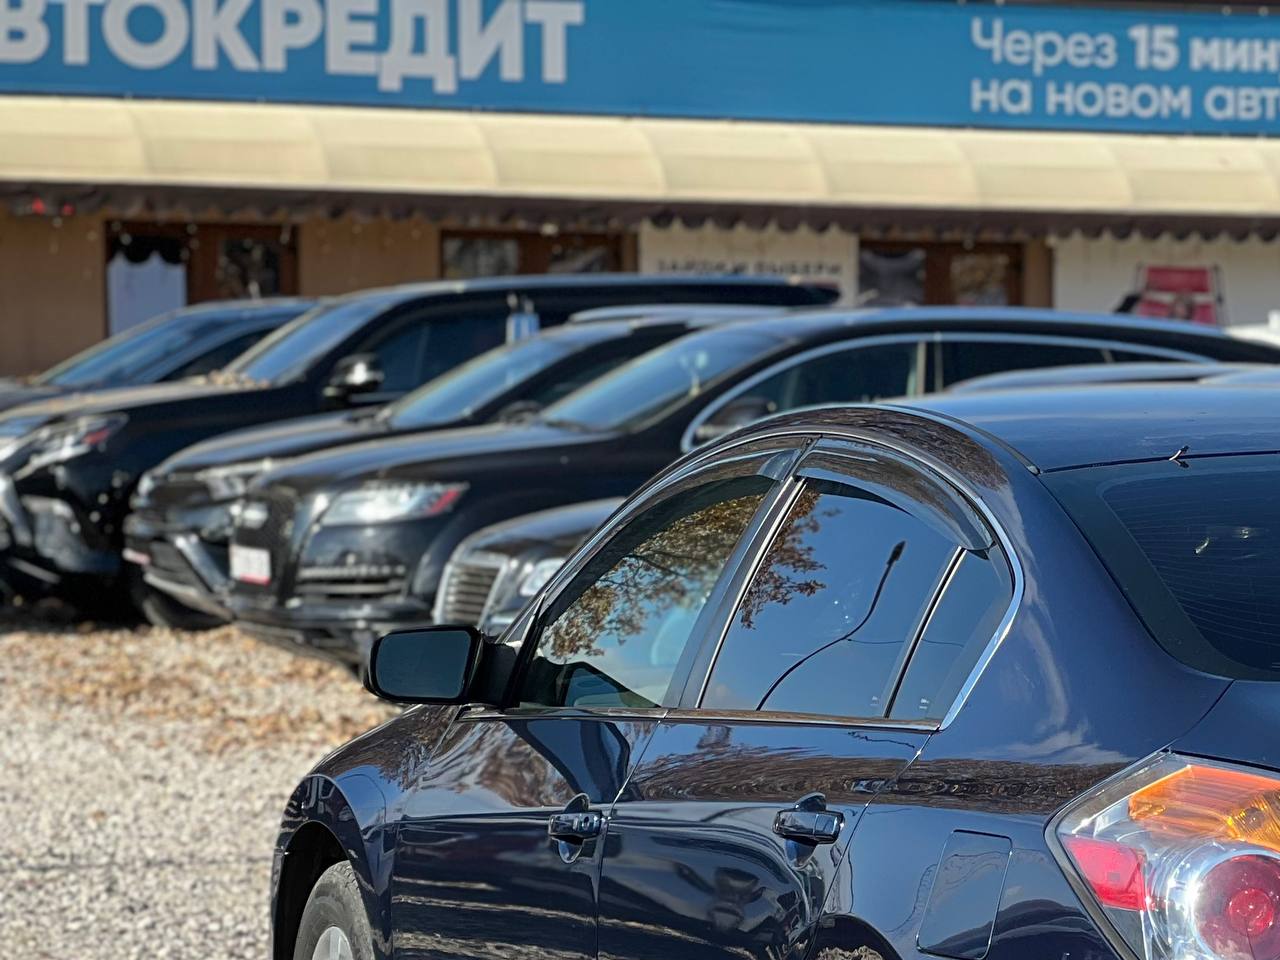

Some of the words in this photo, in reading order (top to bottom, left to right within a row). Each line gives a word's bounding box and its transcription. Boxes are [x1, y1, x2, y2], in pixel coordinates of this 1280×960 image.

[971, 17, 1118, 76] Через
[1128, 24, 1181, 70] 15
[970, 79, 1032, 114] на
[1045, 80, 1193, 119] новом
